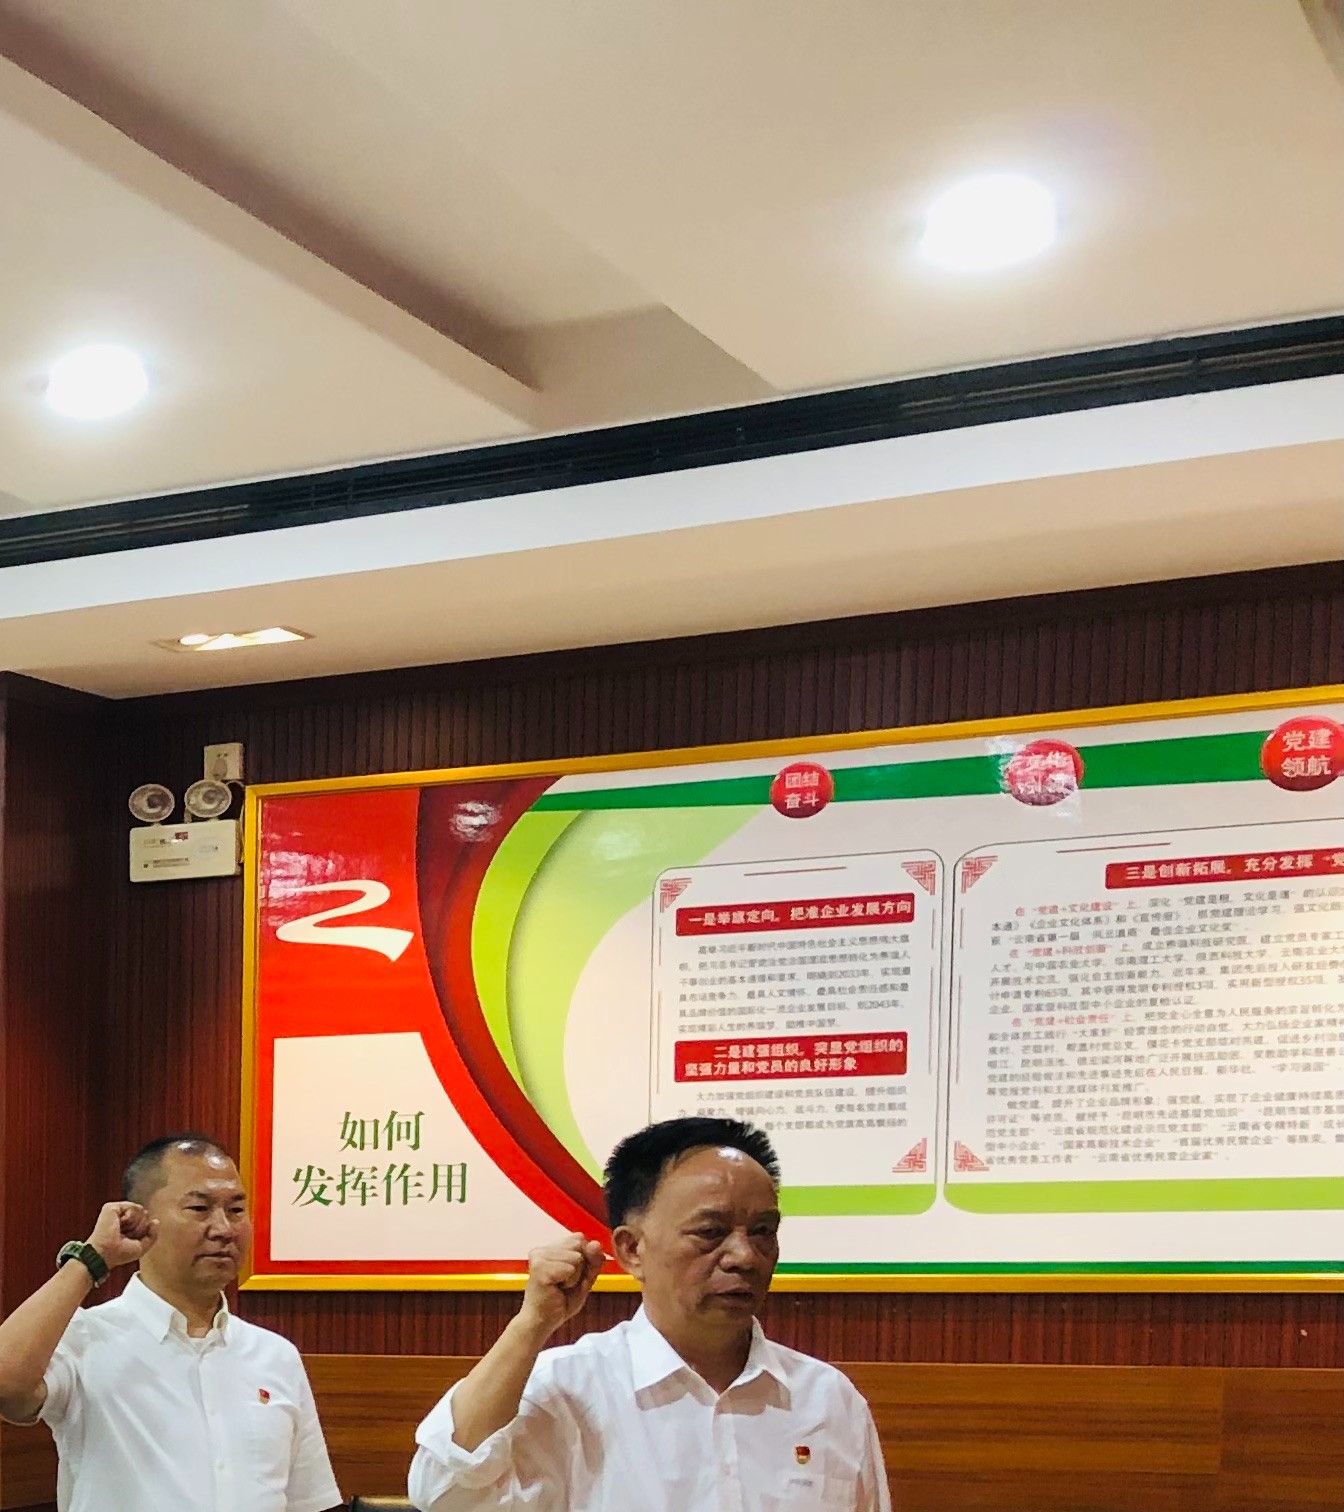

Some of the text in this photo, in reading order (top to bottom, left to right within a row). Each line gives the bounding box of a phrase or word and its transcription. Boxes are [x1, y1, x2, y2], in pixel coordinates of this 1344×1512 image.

[1282, 728, 1332, 753] 党建
[1281, 755, 1332, 778] 领航
[785, 772, 820, 788] 团结
[785, 794, 820, 809] 奋斗
[685, 1057, 858, 1077] 坚强力量和党员的良好形象
[339, 1110, 425, 1152] 如何
[291, 1162, 467, 1207] 发挥作用
